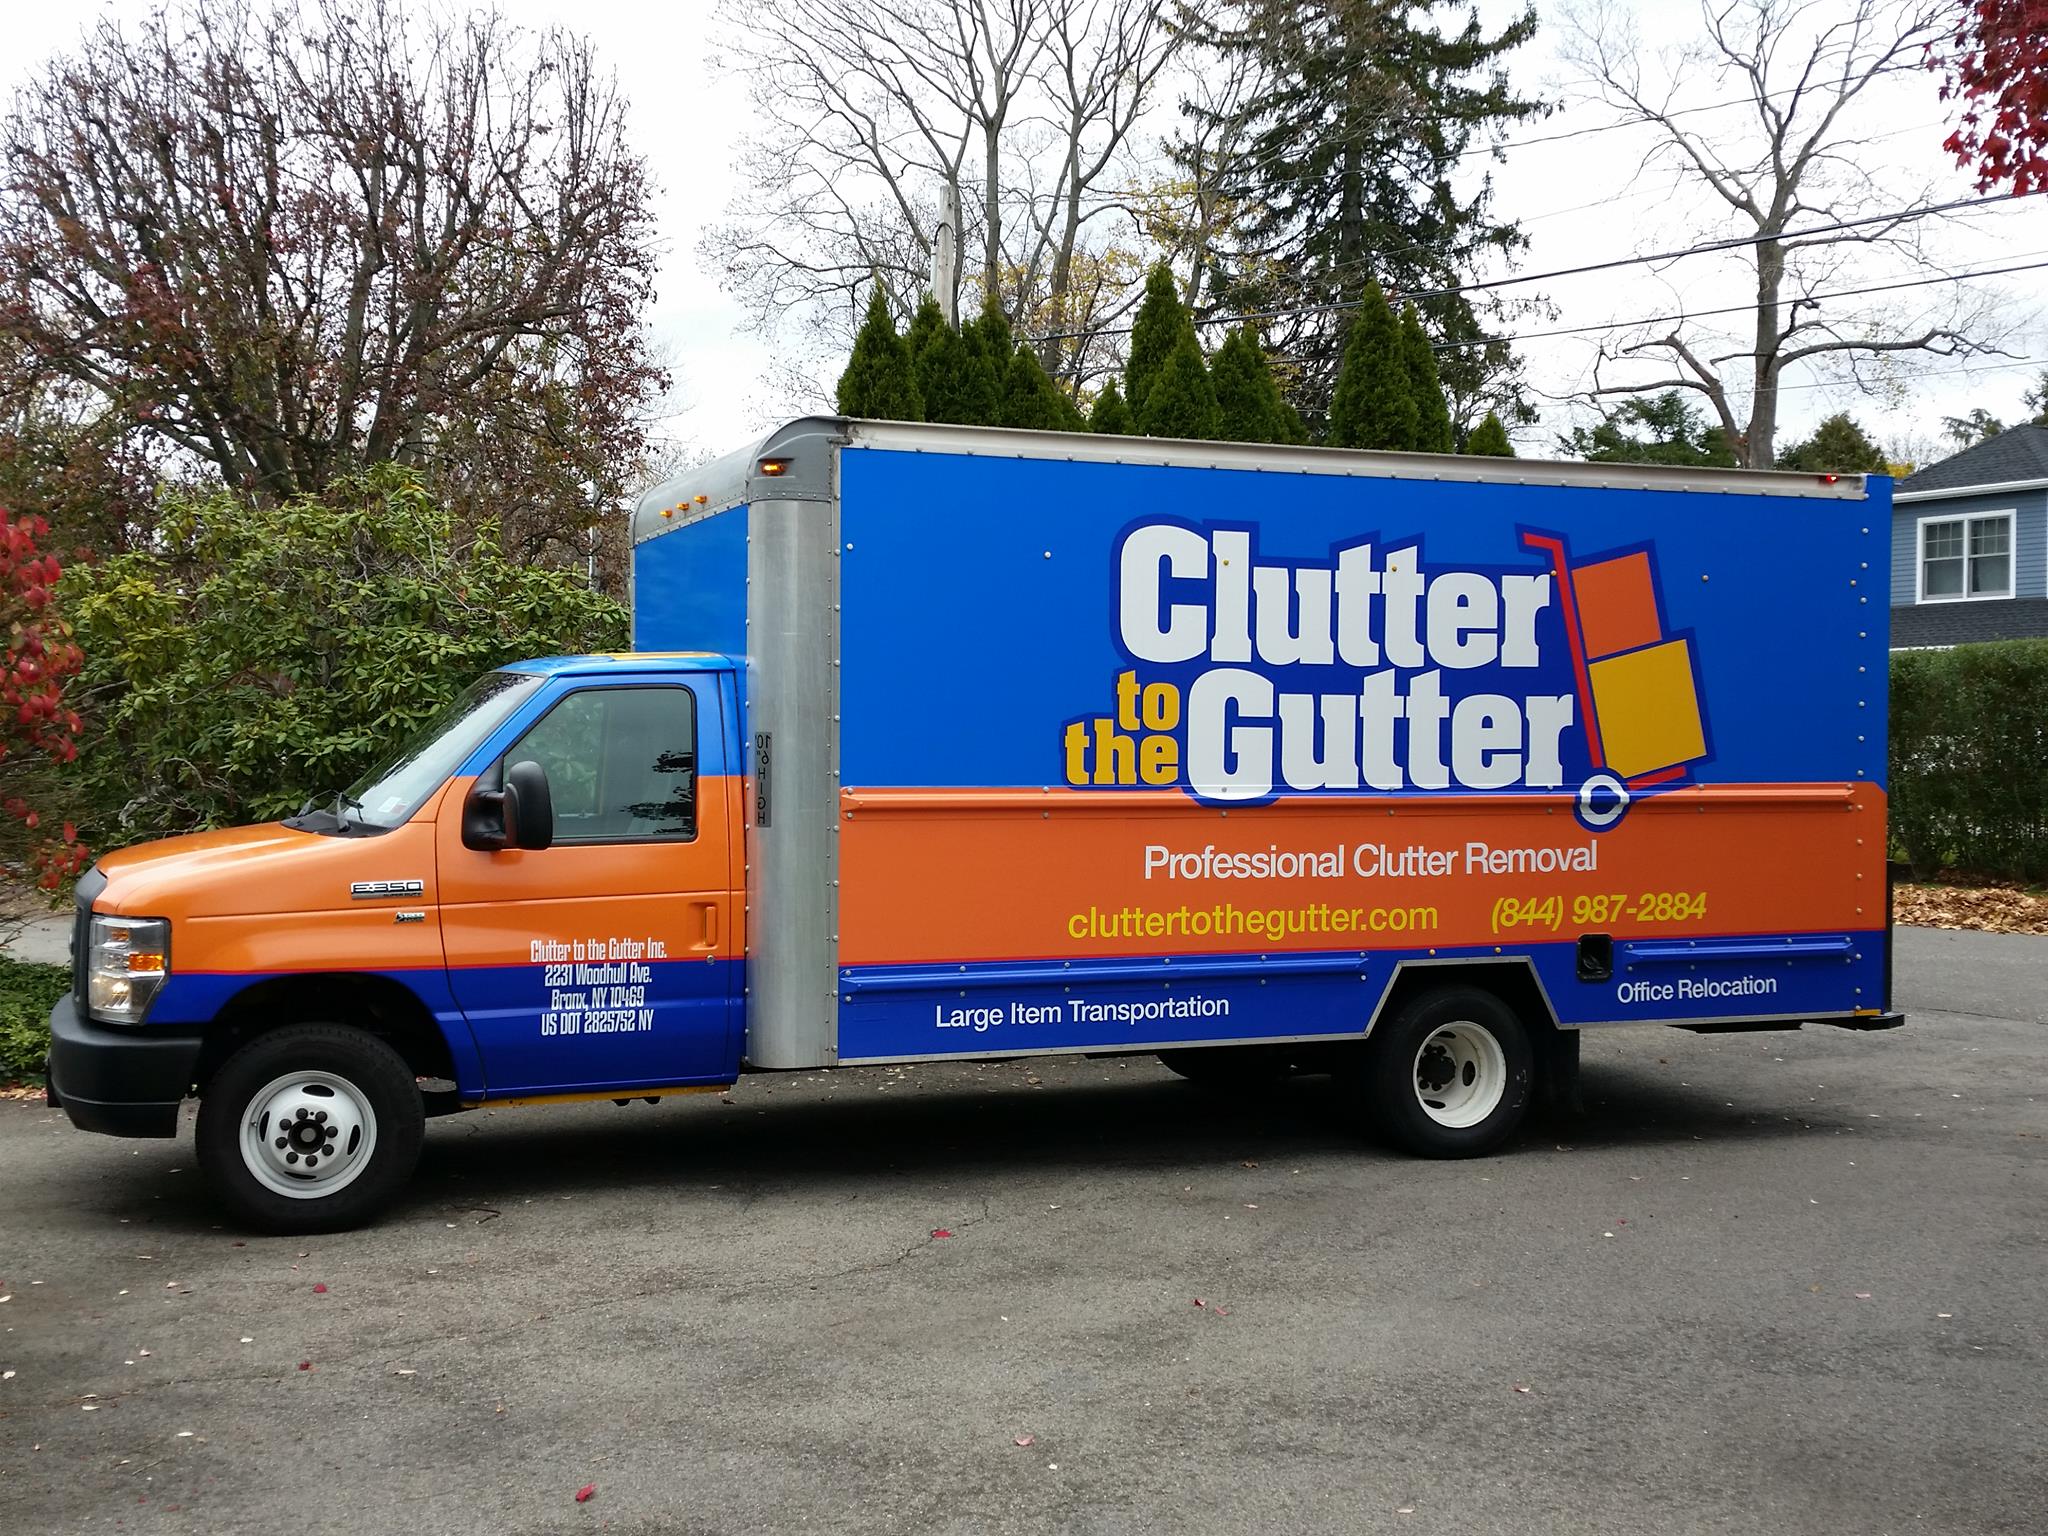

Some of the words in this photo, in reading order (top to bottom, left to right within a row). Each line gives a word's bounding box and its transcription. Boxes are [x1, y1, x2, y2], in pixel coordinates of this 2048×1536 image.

[1119, 524, 1551, 669] Clutter
[1116, 671, 1181, 731] to
[1064, 719, 1180, 785] the
[1187, 667, 1574, 801] Gutter
[1145, 844, 1345, 880] Professional
[1353, 843, 1459, 877] Clutter
[1466, 839, 1597, 874] Removal
[1068, 904, 1438, 941] cluttertothegutter.com
[1491, 895, 1564, 934] (844)
[1572, 893, 1706, 924] 987-2884
[530, 939, 571, 962] Clutter
[573, 939, 585, 960] to
[587, 939, 606, 960] the
[608, 937, 645, 960] Gutter
[647, 937, 667, 958] Inc.
[544, 964, 573, 987] 2231
[576, 962, 626, 985] Woodhull
[630, 962, 653, 983] Ave.
[1617, 981, 1674, 1003] Office
[1678, 975, 1778, 999] Relocation
[551, 989, 589, 1011] Bronx,
[591, 987, 608, 1009] NY
[609, 986, 644, 1008] 10469
[936, 1005, 1004, 1032] Large
[1011, 1002, 1062, 1025] Item
[1067, 995, 1230, 1025] Transportation
[541, 1013, 557, 1036] US
[560, 1012, 582, 1035] DOT
[584, 1010, 635, 1034] 2825752
[638, 1009, 655, 1031] NY
